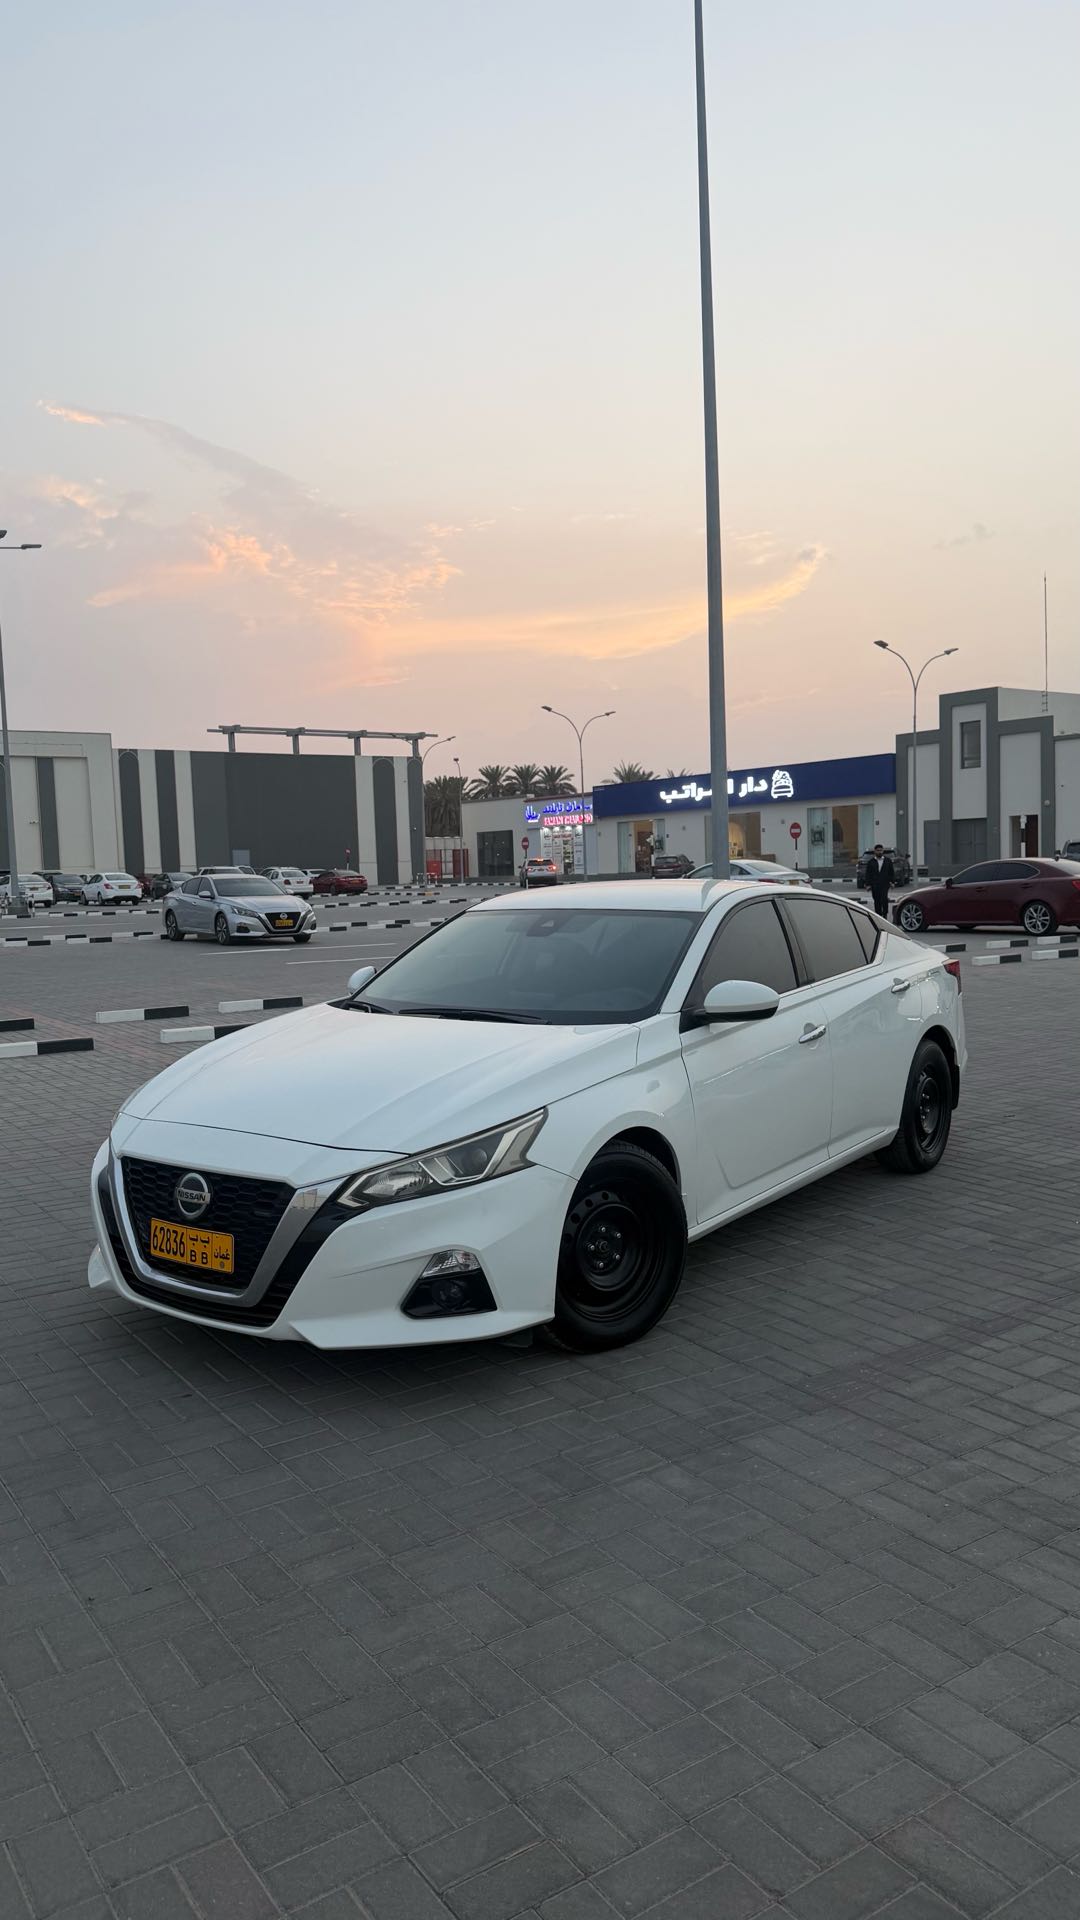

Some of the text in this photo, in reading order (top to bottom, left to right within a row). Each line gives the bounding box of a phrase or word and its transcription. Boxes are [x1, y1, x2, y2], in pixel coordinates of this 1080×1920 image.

[659, 776, 768, 804] دار اراتب
[177, 1189, 206, 1202] NISSAN
[152, 1225, 186, 1258] 62836
[190, 1249, 209, 1265] B B
